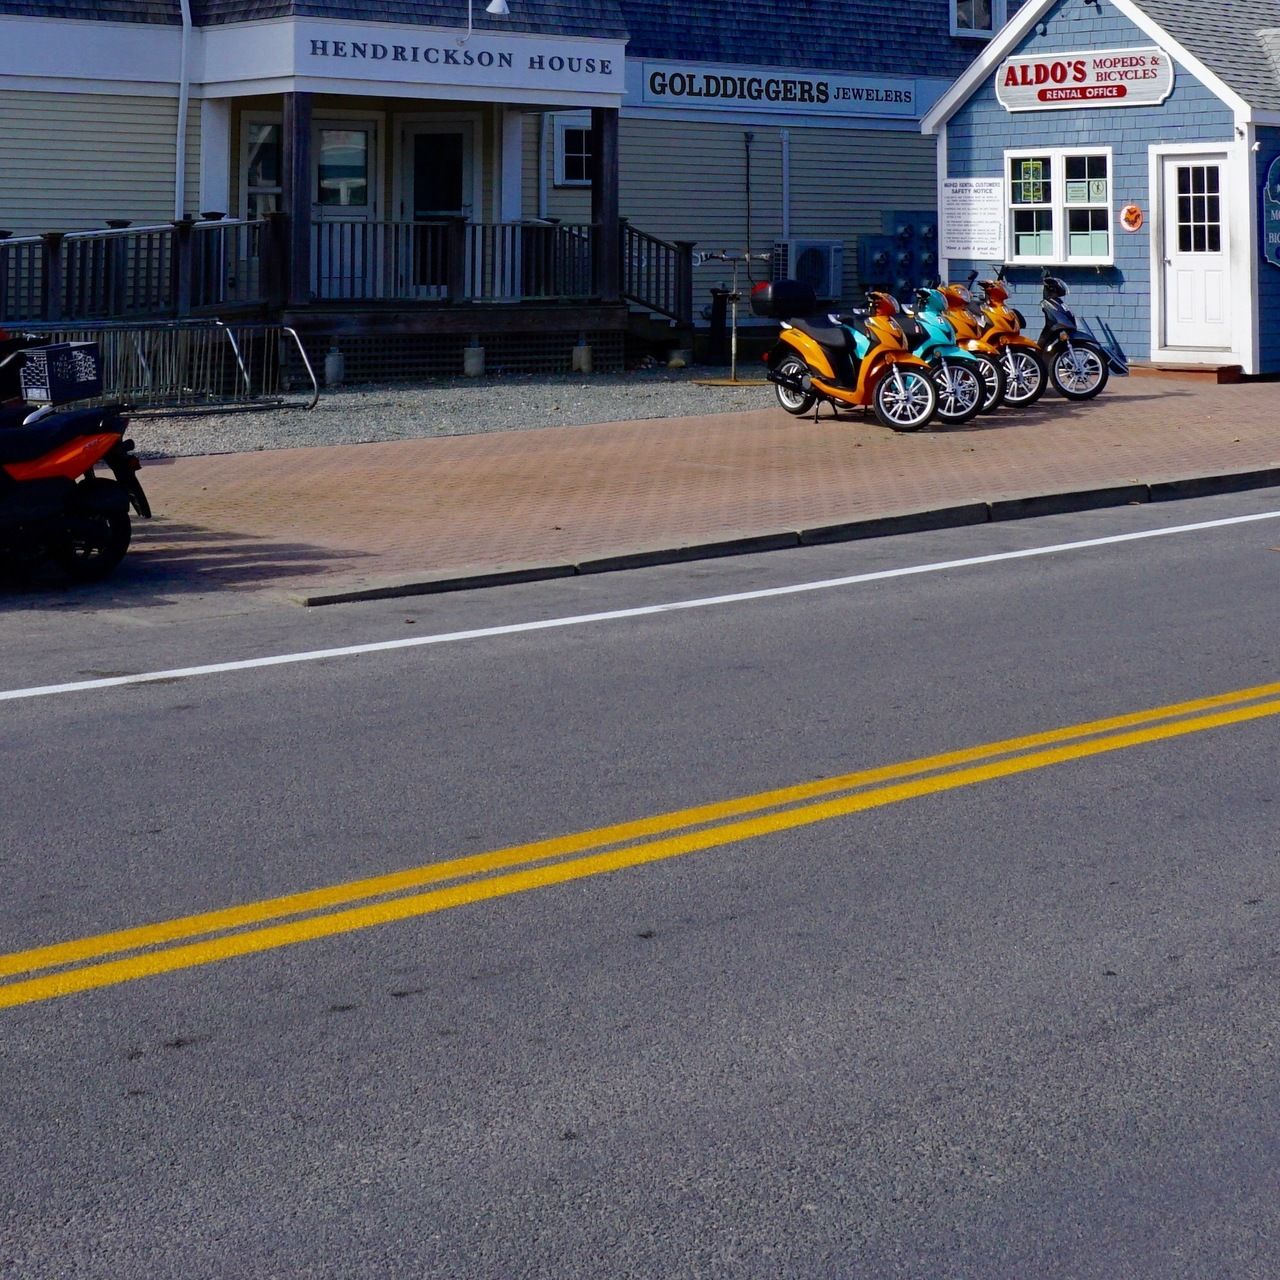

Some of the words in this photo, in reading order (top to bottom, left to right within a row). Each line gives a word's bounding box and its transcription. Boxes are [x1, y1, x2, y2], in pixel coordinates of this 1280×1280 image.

[310, 40, 513, 68] HENDRICKSON
[528, 55, 613, 75] HOUSE
[1004, 60, 1087, 86] ALDO'S
[1093, 56, 1145, 69] MOPEDS
[1150, 56, 1160, 66] &
[649, 72, 830, 104] GOLDDIGGERS
[833, 87, 912, 104] JEWELERS
[1096, 68, 1157, 82] BICYCLES
[1046, 89, 1082, 100] RENTAL
[1086, 87, 1118, 98] OFFICE
